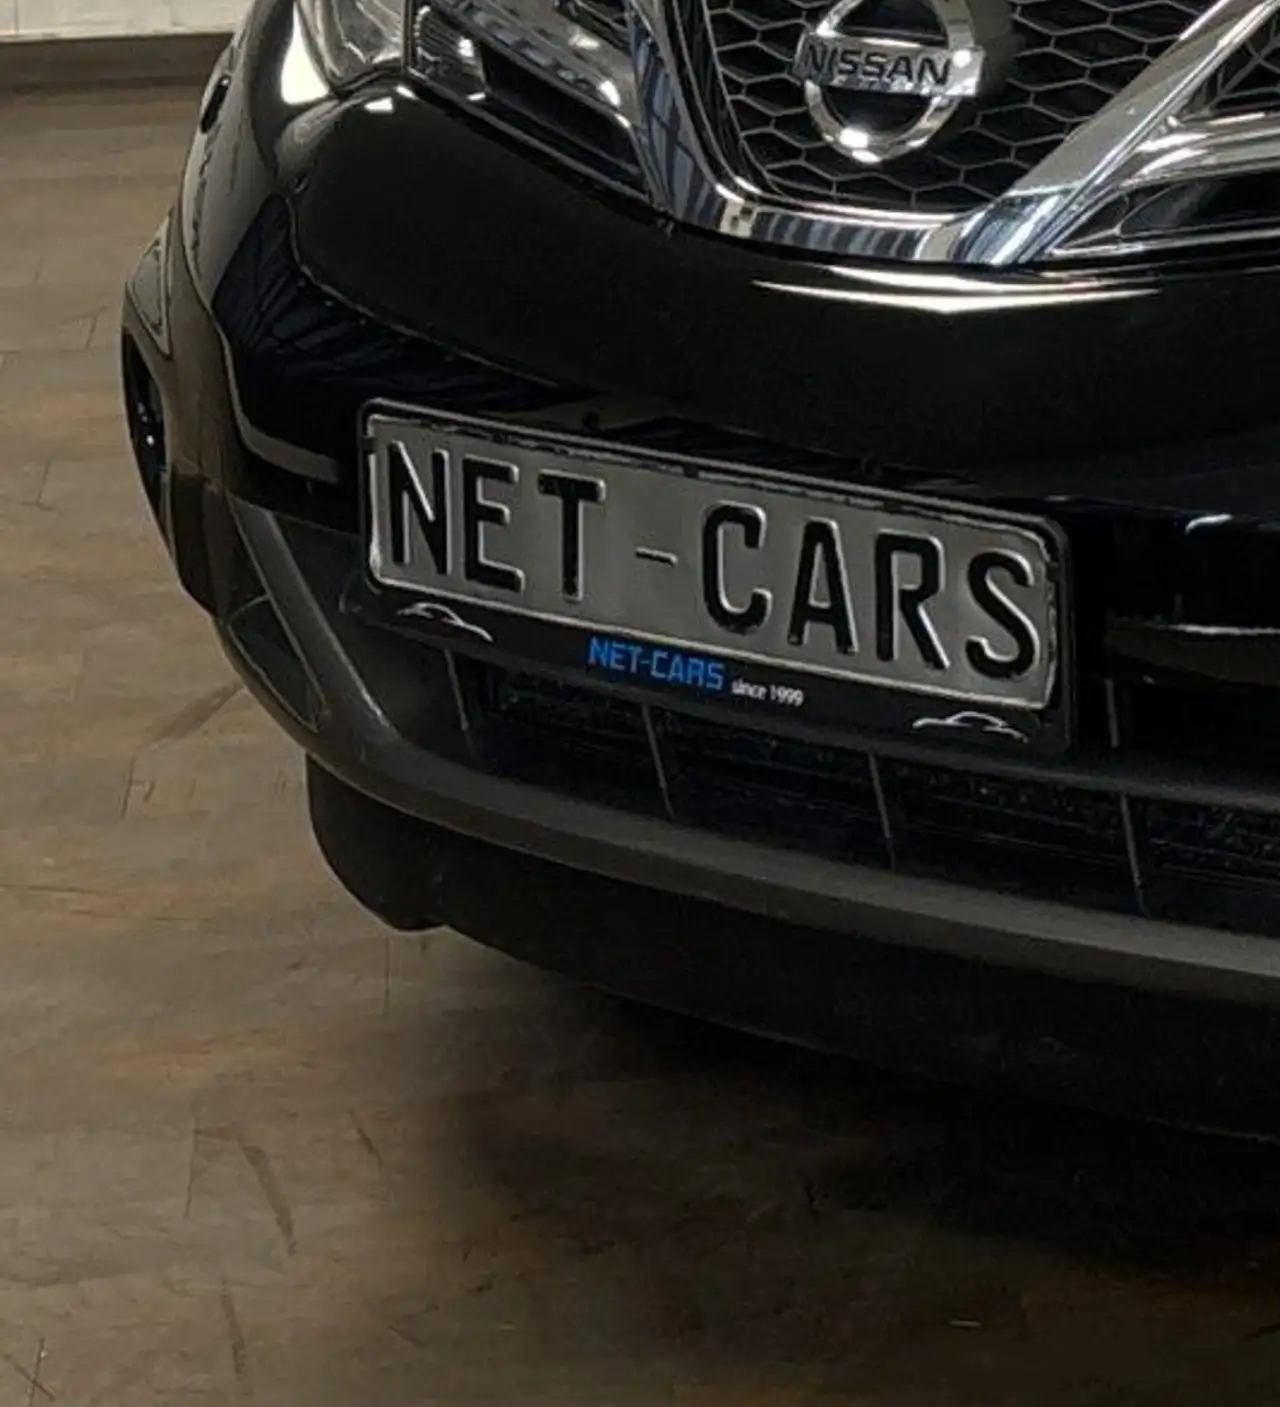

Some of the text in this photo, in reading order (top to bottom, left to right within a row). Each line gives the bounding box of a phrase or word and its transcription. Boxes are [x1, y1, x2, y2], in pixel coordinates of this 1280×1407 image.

[804, 43, 953, 86] NISSAN
[586, 635, 805, 708] NET-CARS since 1999
